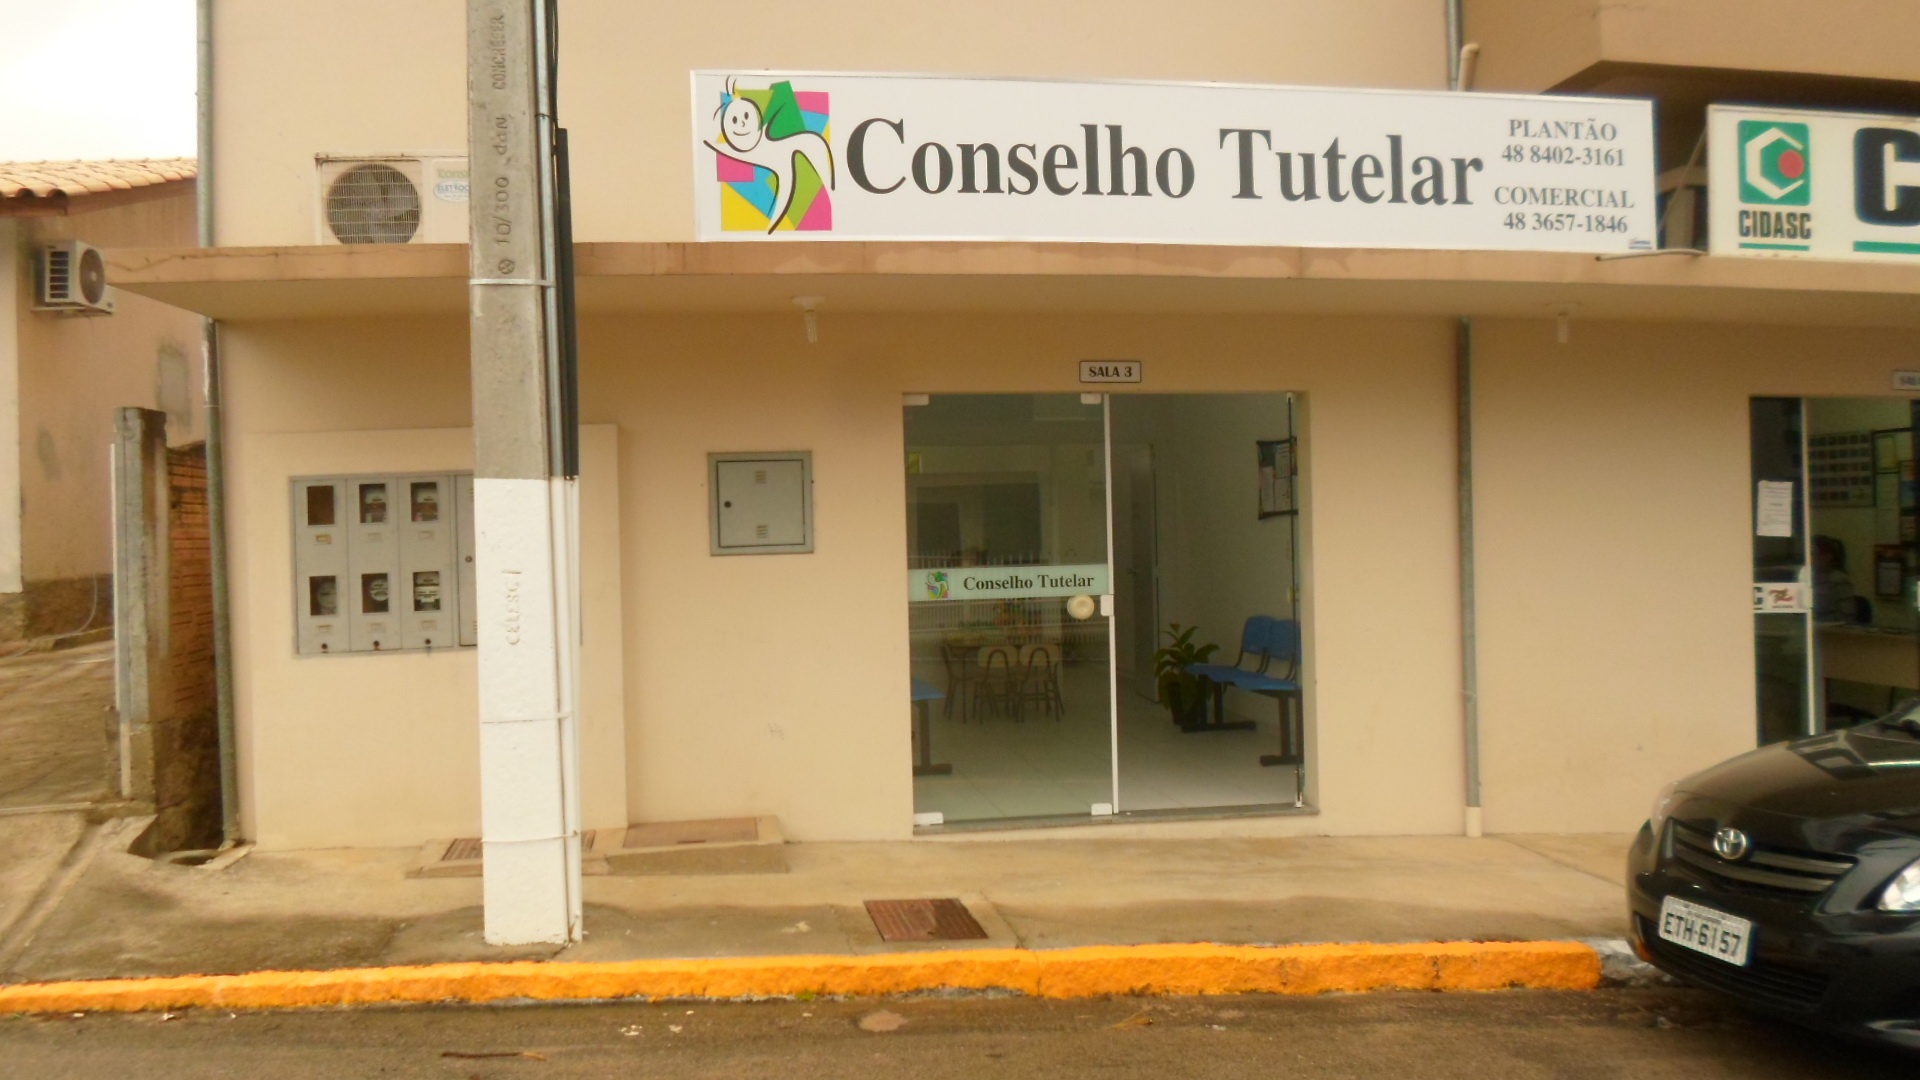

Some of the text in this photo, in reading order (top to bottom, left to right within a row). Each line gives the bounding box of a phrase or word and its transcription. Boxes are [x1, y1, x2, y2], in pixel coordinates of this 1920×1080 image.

[1508, 118, 1618, 142] PLANTÃO
[846, 117, 1484, 206] Conselho Tutelar
[1502, 144, 1625, 167] 48 8402-3161
[1494, 185, 1635, 209] COMERCIAL
[1503, 211, 1628, 234] 48 3657-1846
[1738, 209, 1812, 240] CIDASC
[1089, 366, 1132, 378] SALA 3
[963, 573, 1094, 591] Conselho Tutelar
[1664, 912, 1742, 958] ETH-6157
